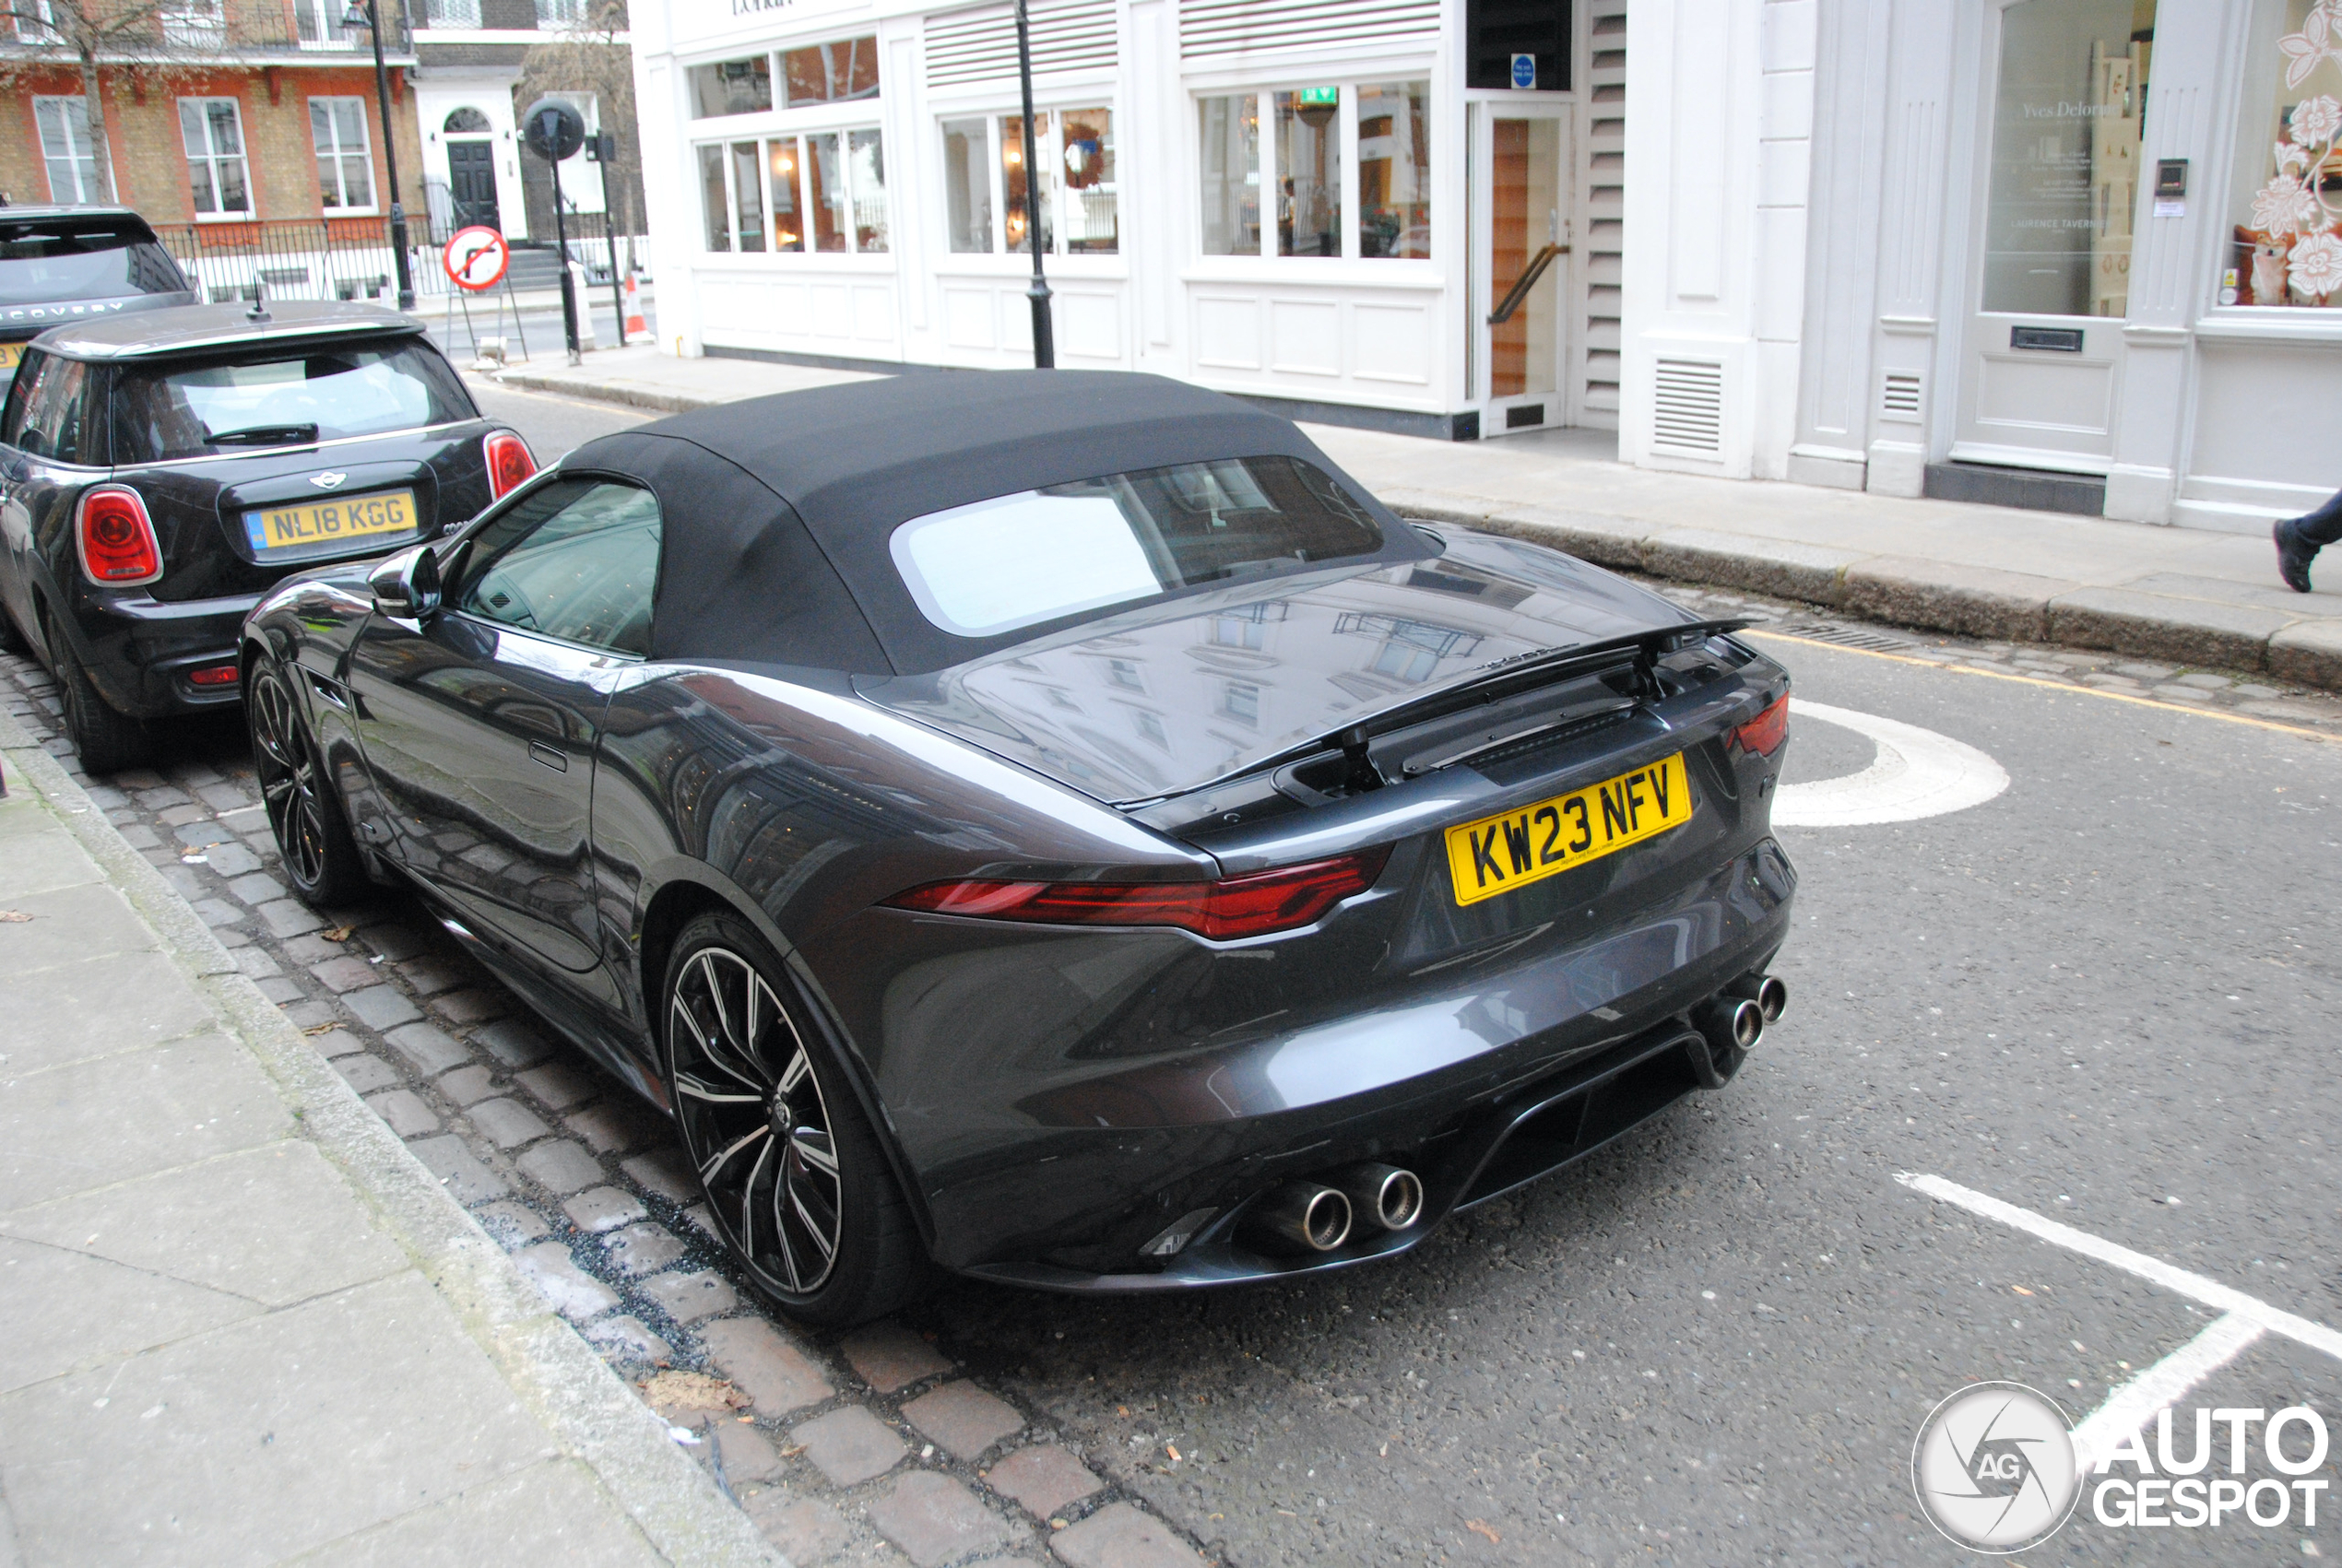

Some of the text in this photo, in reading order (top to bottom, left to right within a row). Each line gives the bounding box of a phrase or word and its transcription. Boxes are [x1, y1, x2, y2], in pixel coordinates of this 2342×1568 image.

[2023, 102, 2053, 118] Yves
[2011, 219, 2057, 228] LAURENCE
[0, 301, 124, 320] COVERY
[274, 499, 405, 540] NL18 KGG
[1470, 763, 1668, 889] KW23 NFV
